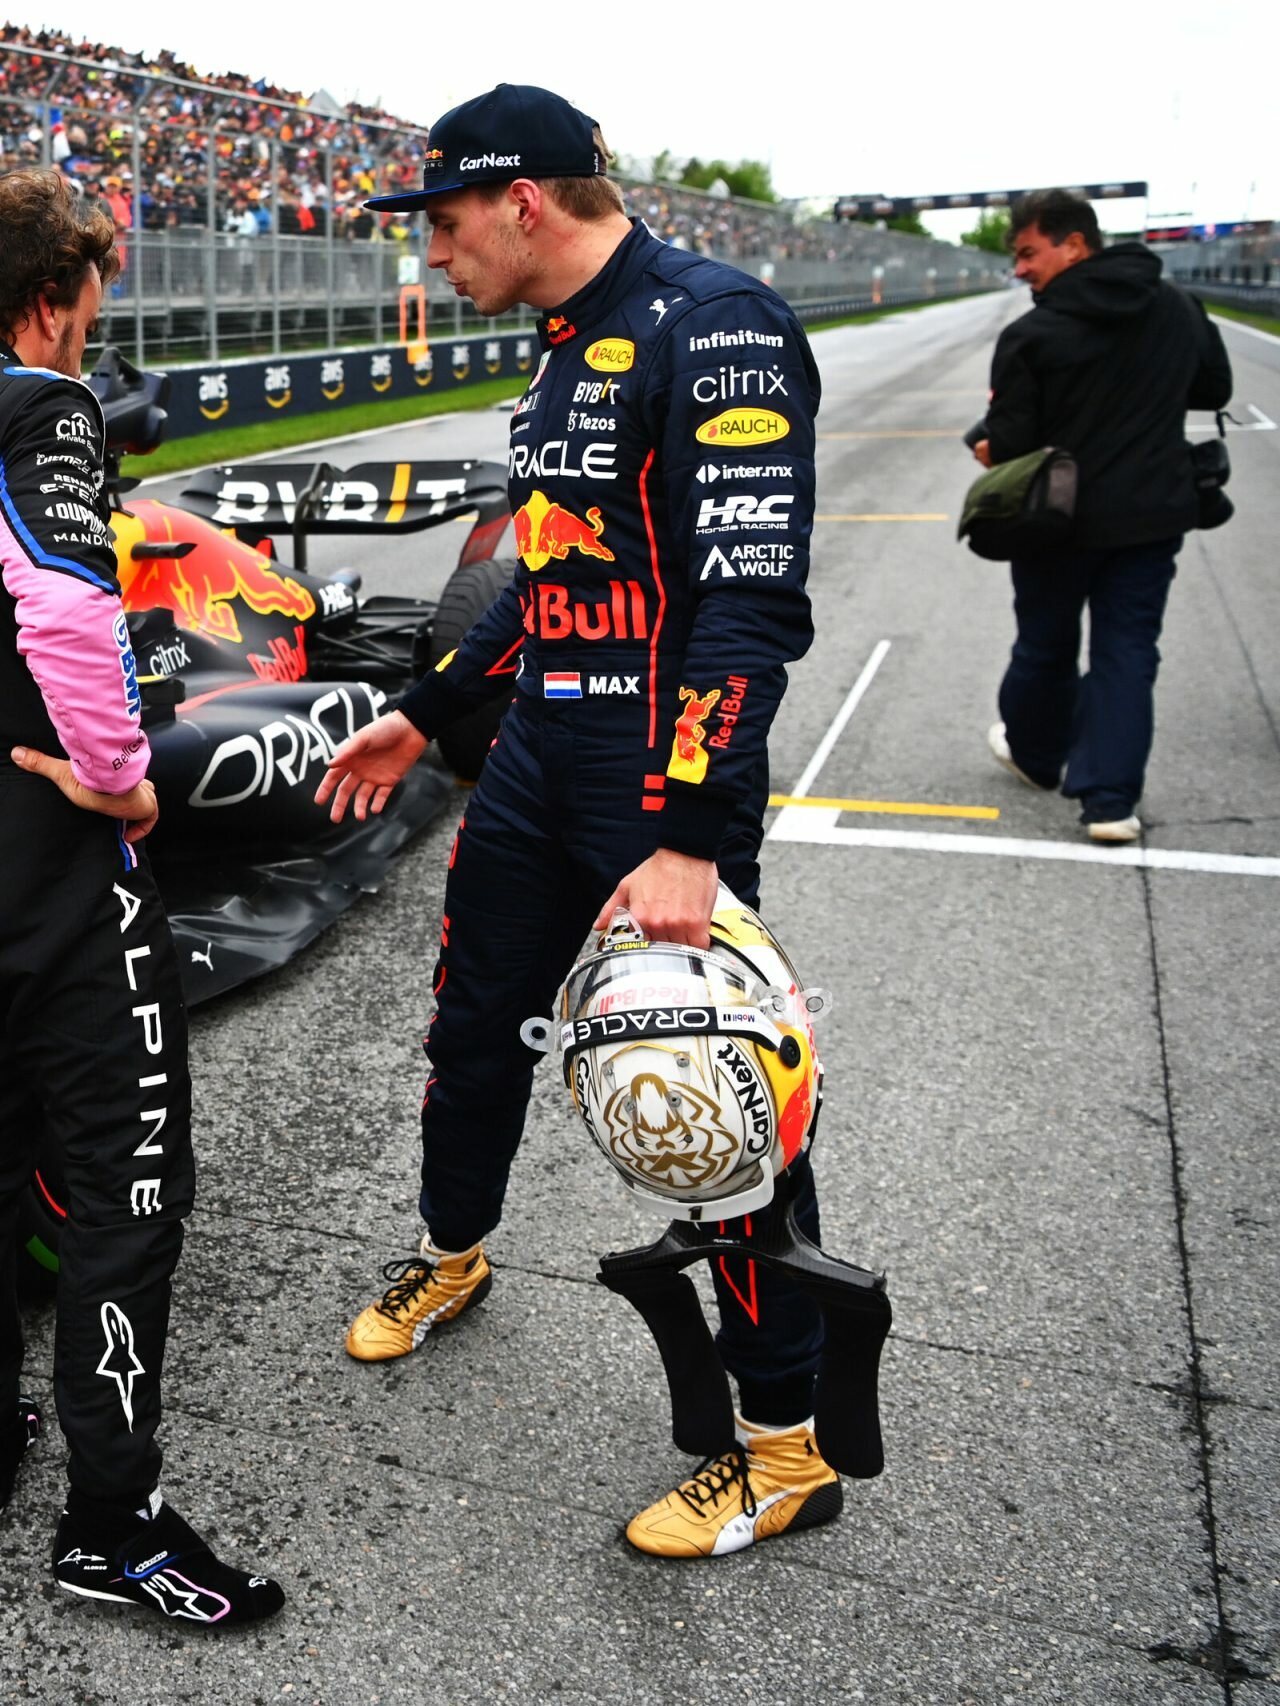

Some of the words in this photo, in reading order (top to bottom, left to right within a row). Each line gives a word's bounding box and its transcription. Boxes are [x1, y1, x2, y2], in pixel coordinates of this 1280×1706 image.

[460, 152, 521, 171] CarNext
[689, 329, 784, 352] infinitum
[600, 347, 633, 365] RAUCH
[572, 377, 621, 405] BYBIT
[692, 364, 789, 403] citrix
[578, 412, 617, 431] Tezos
[720, 418, 779, 436] RAUCH
[722, 464, 793, 480] inter.mx
[53, 474, 100, 500] RENAULT
[212, 464, 466, 523] BYBIT
[56, 502, 107, 536] DUPONT
[696, 494, 794, 527] HRC
[696, 525, 738, 535] Honda
[740, 522, 789, 530] RACING
[730, 544, 794, 560] ARCTIC
[739, 561, 789, 577] WOLF
[537, 580, 648, 639] Bull
[150, 637, 192, 677] citrix
[588, 676, 640, 695] MAX
[720, 675, 748, 713] Bull
[708, 712, 736, 749] Red
[576, 1008, 710, 1041] ORACLE
[732, 1014, 756, 1023] Mobil
[112, 881, 168, 1217] ALPINE
[717, 1042, 769, 1155] CarNext
[687, 1205, 703, 1220] 1
